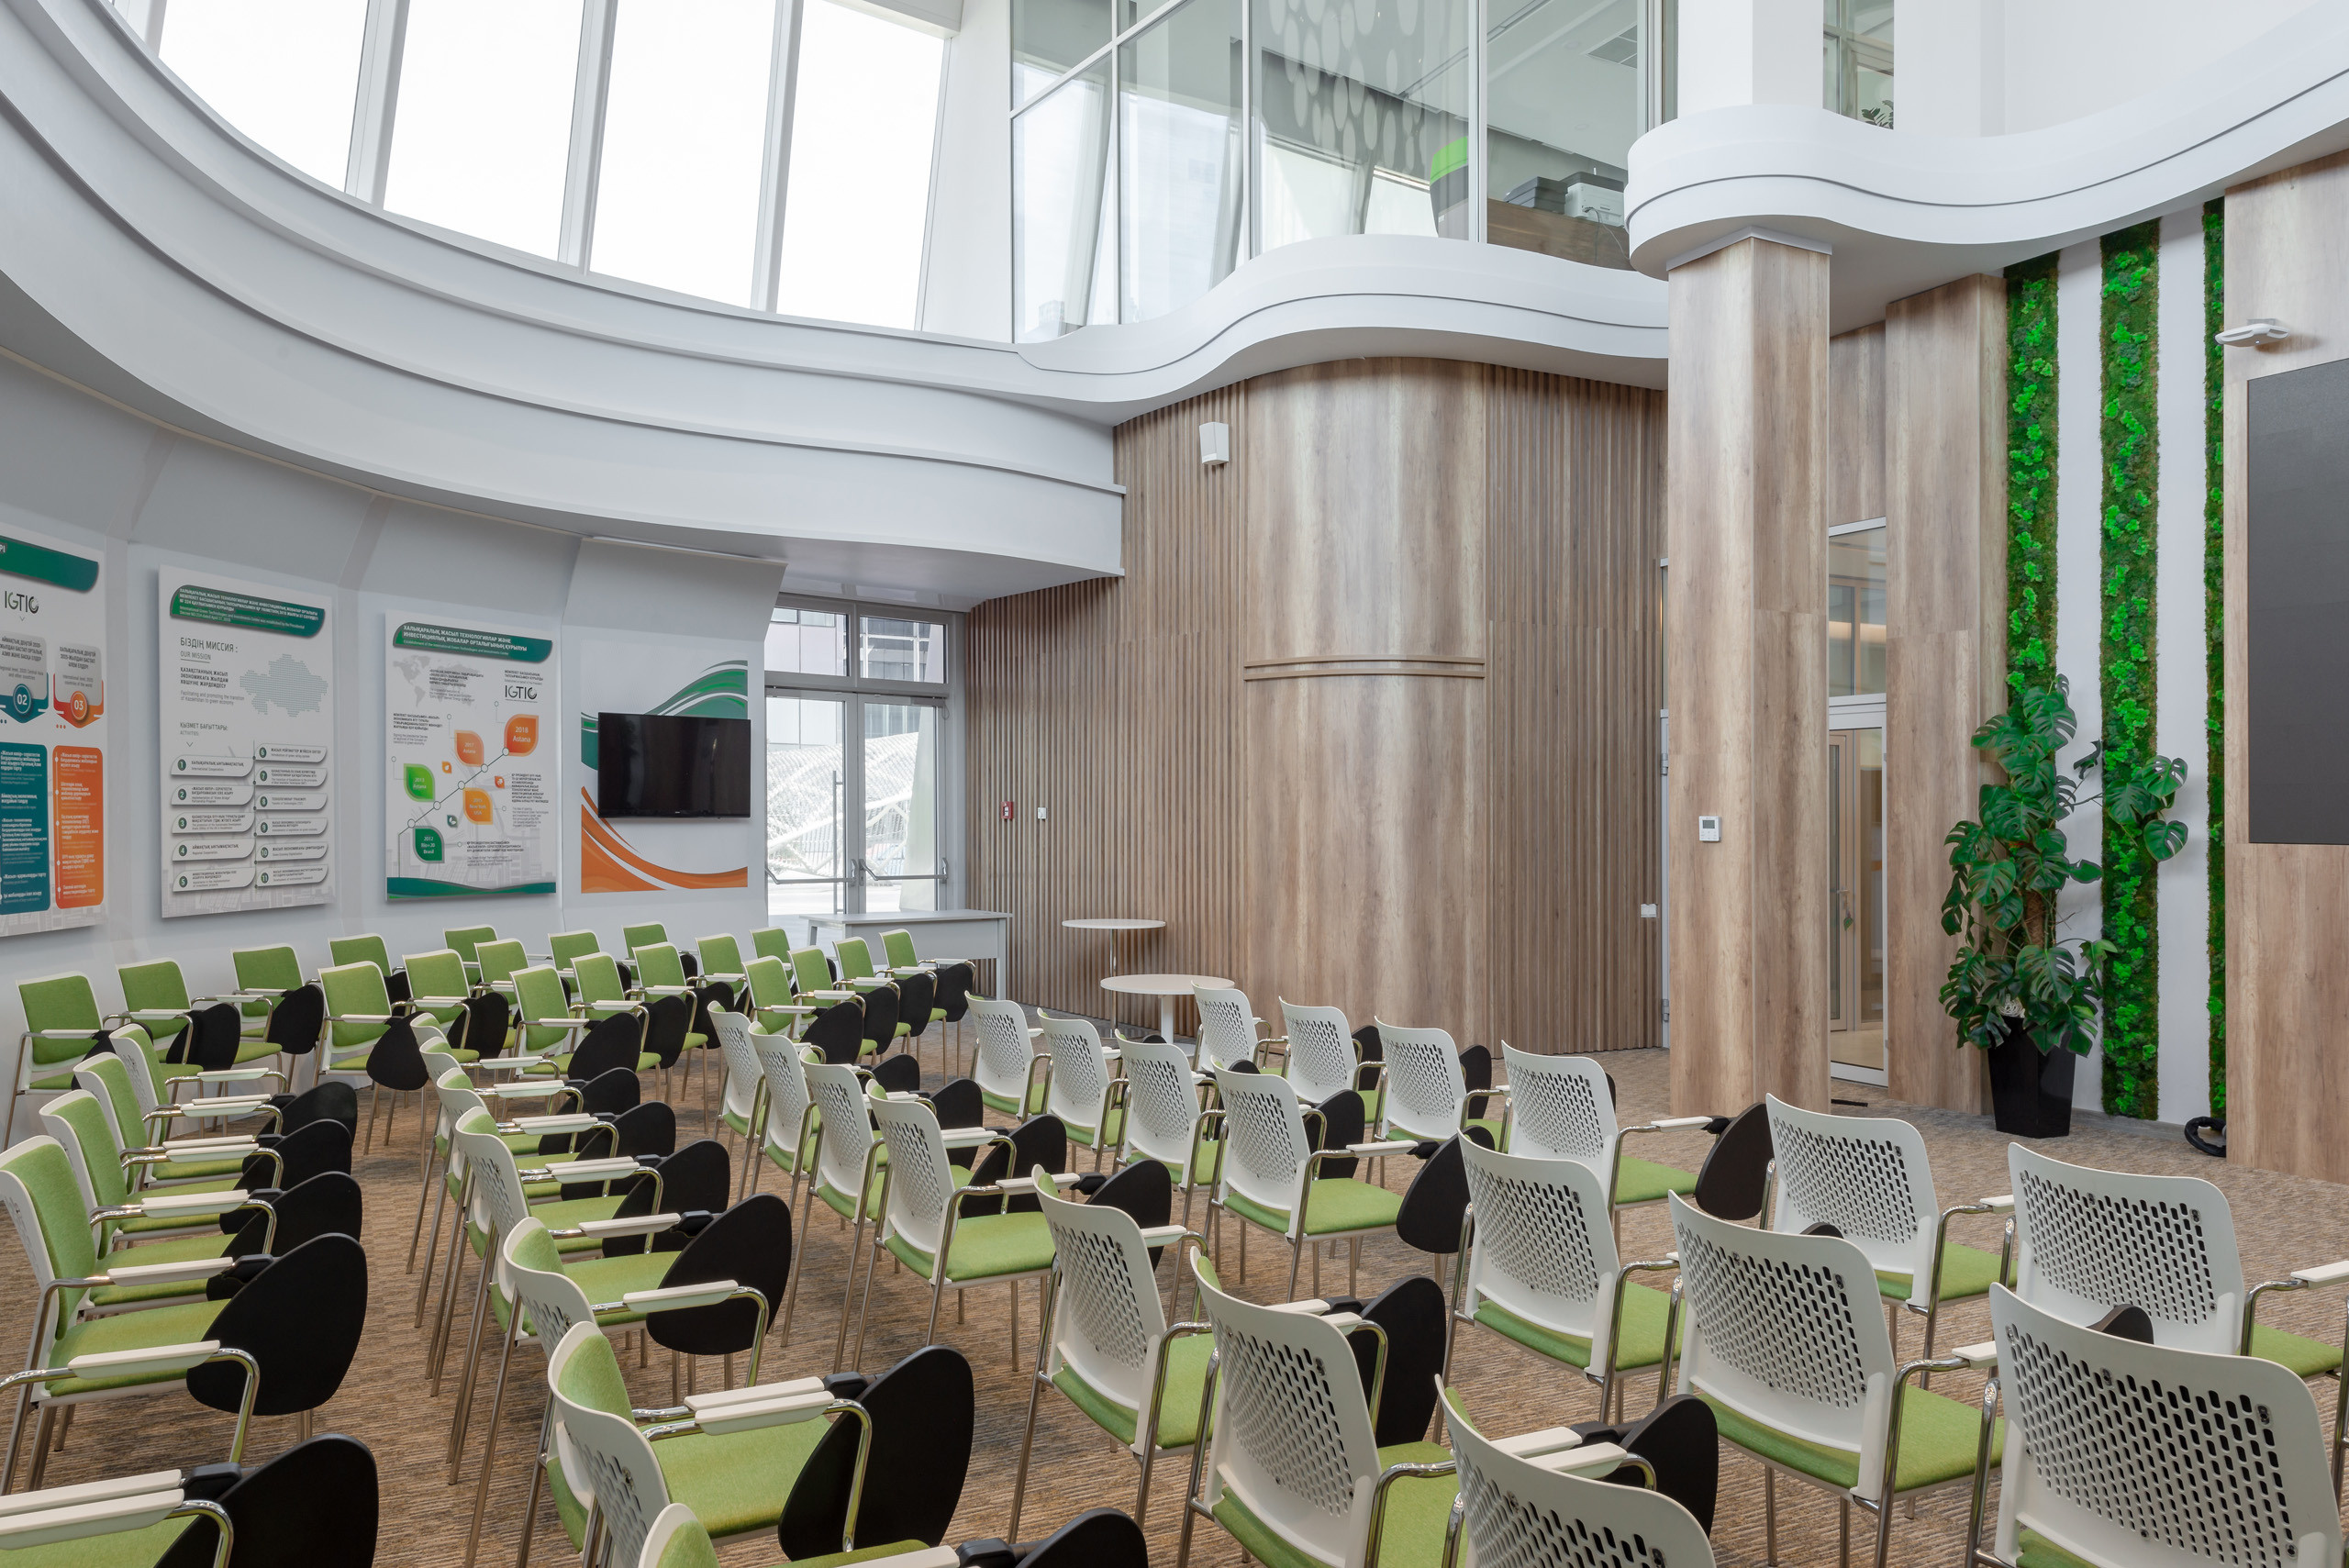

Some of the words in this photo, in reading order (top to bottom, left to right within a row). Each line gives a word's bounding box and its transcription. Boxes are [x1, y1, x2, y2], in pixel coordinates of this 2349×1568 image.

[5, 590, 39, 614] IGTIC
[181, 637, 205, 650] БІЗДІҢ
[206, 640, 234, 652] МИССИЯ
[17, 694, 28, 706] 02
[505, 685, 538, 700] IGTIC
[73, 699, 84, 711] 03
